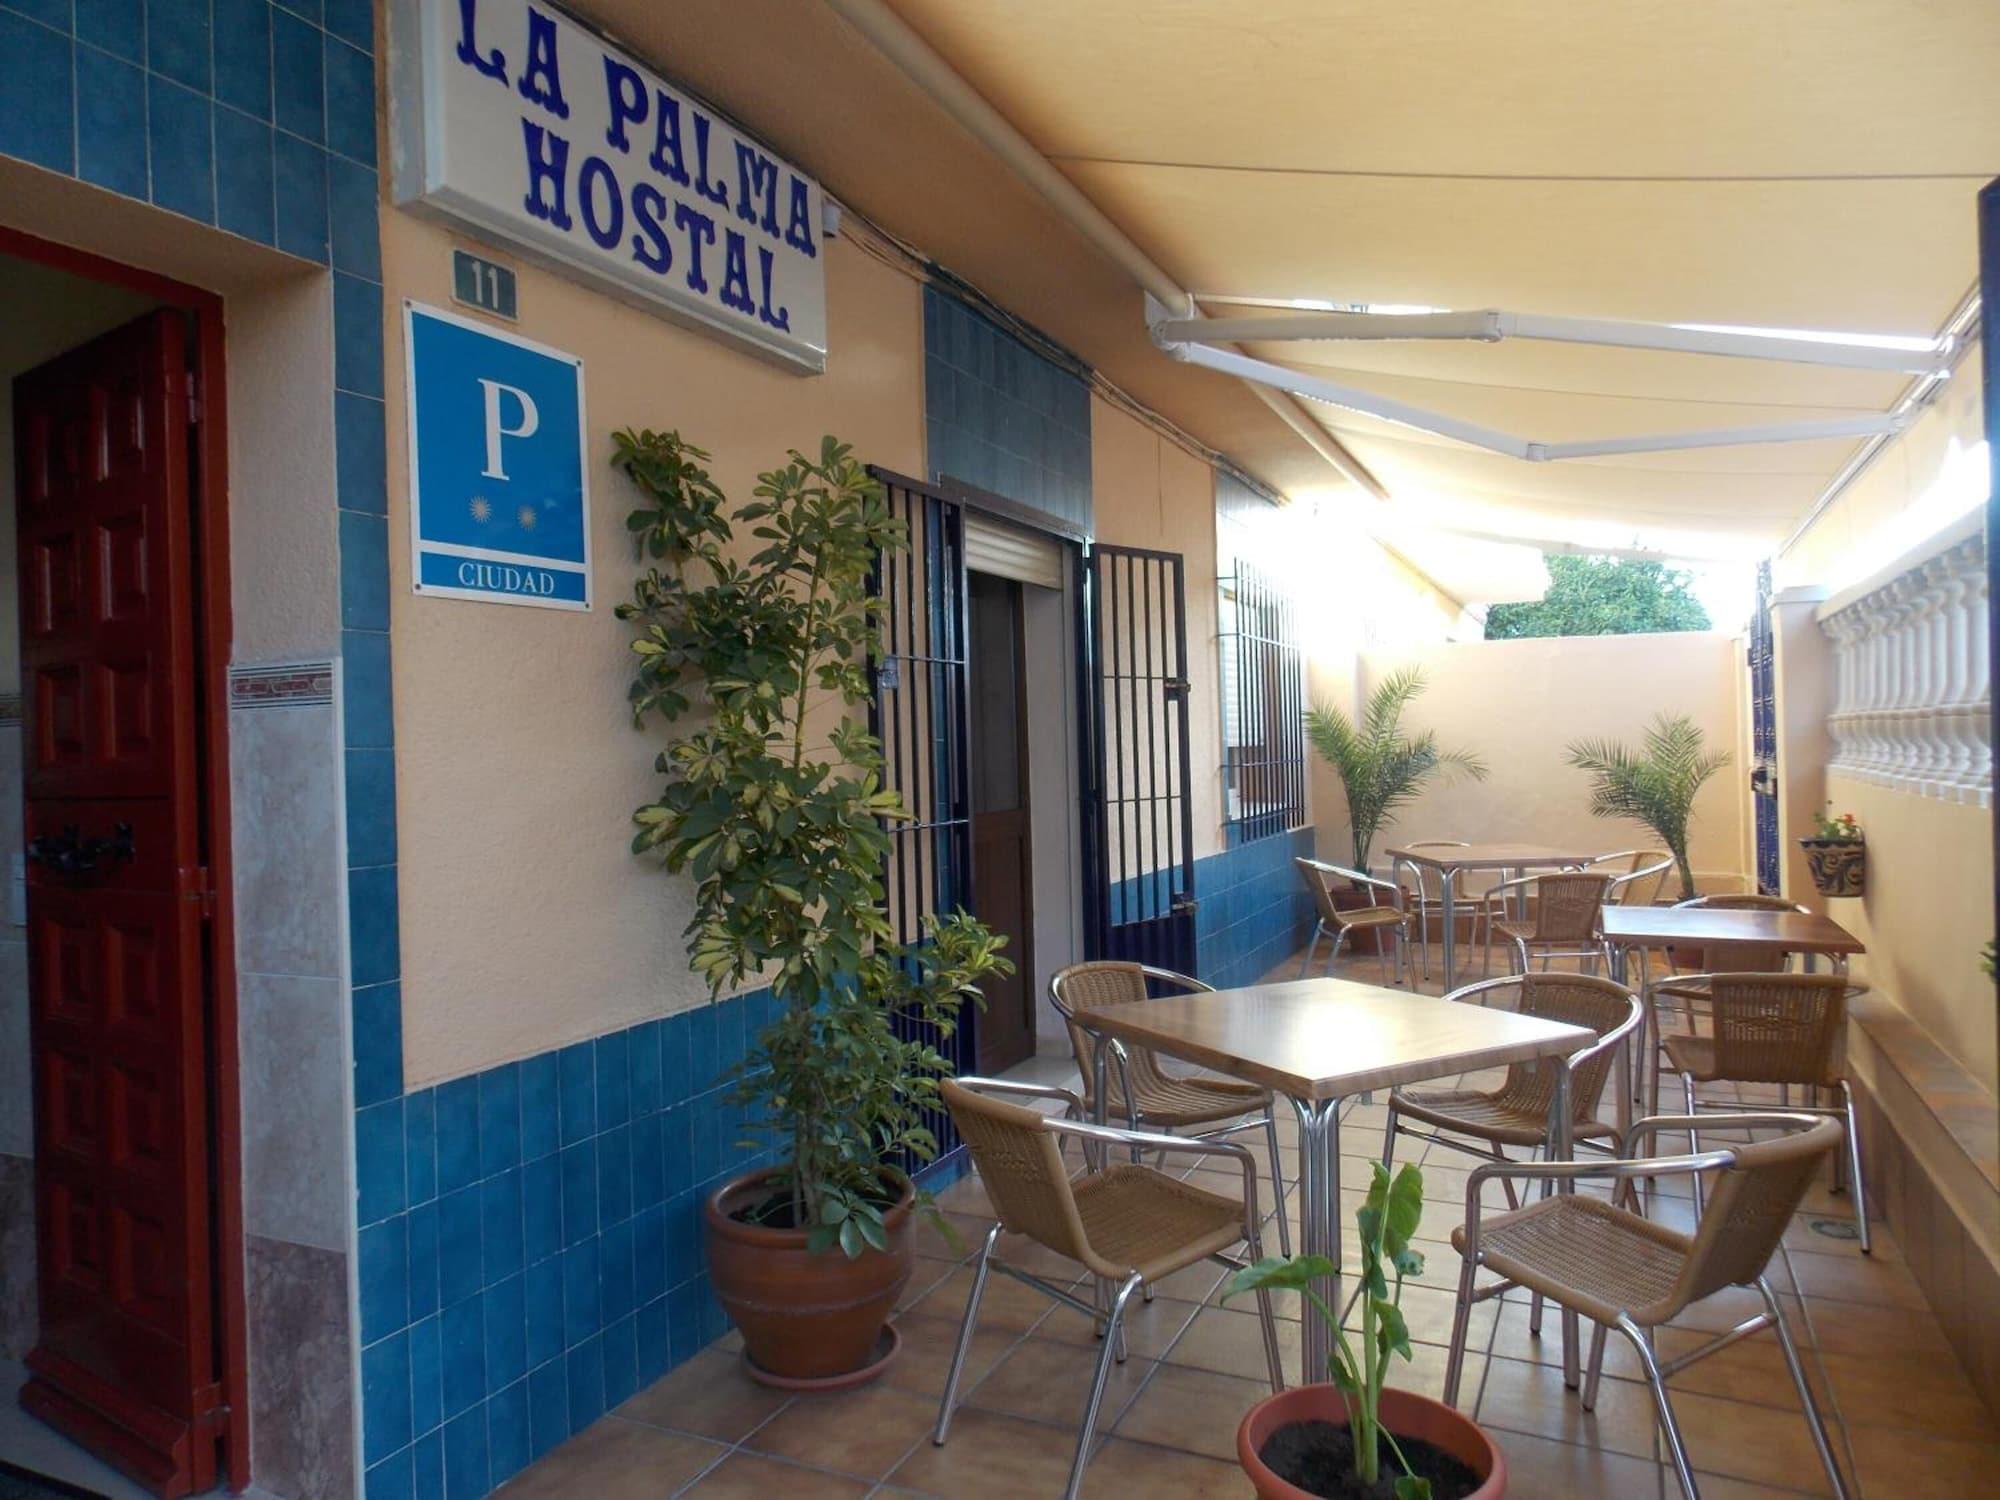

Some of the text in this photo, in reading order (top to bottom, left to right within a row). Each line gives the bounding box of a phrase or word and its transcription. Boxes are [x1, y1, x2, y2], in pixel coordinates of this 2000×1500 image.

[457, 0, 817, 258] LA PALMA
[521, 116, 790, 333] HOSTAL
[471, 259, 499, 310] 11
[477, 377, 539, 481] P
[458, 562, 555, 596] CIUDAD
